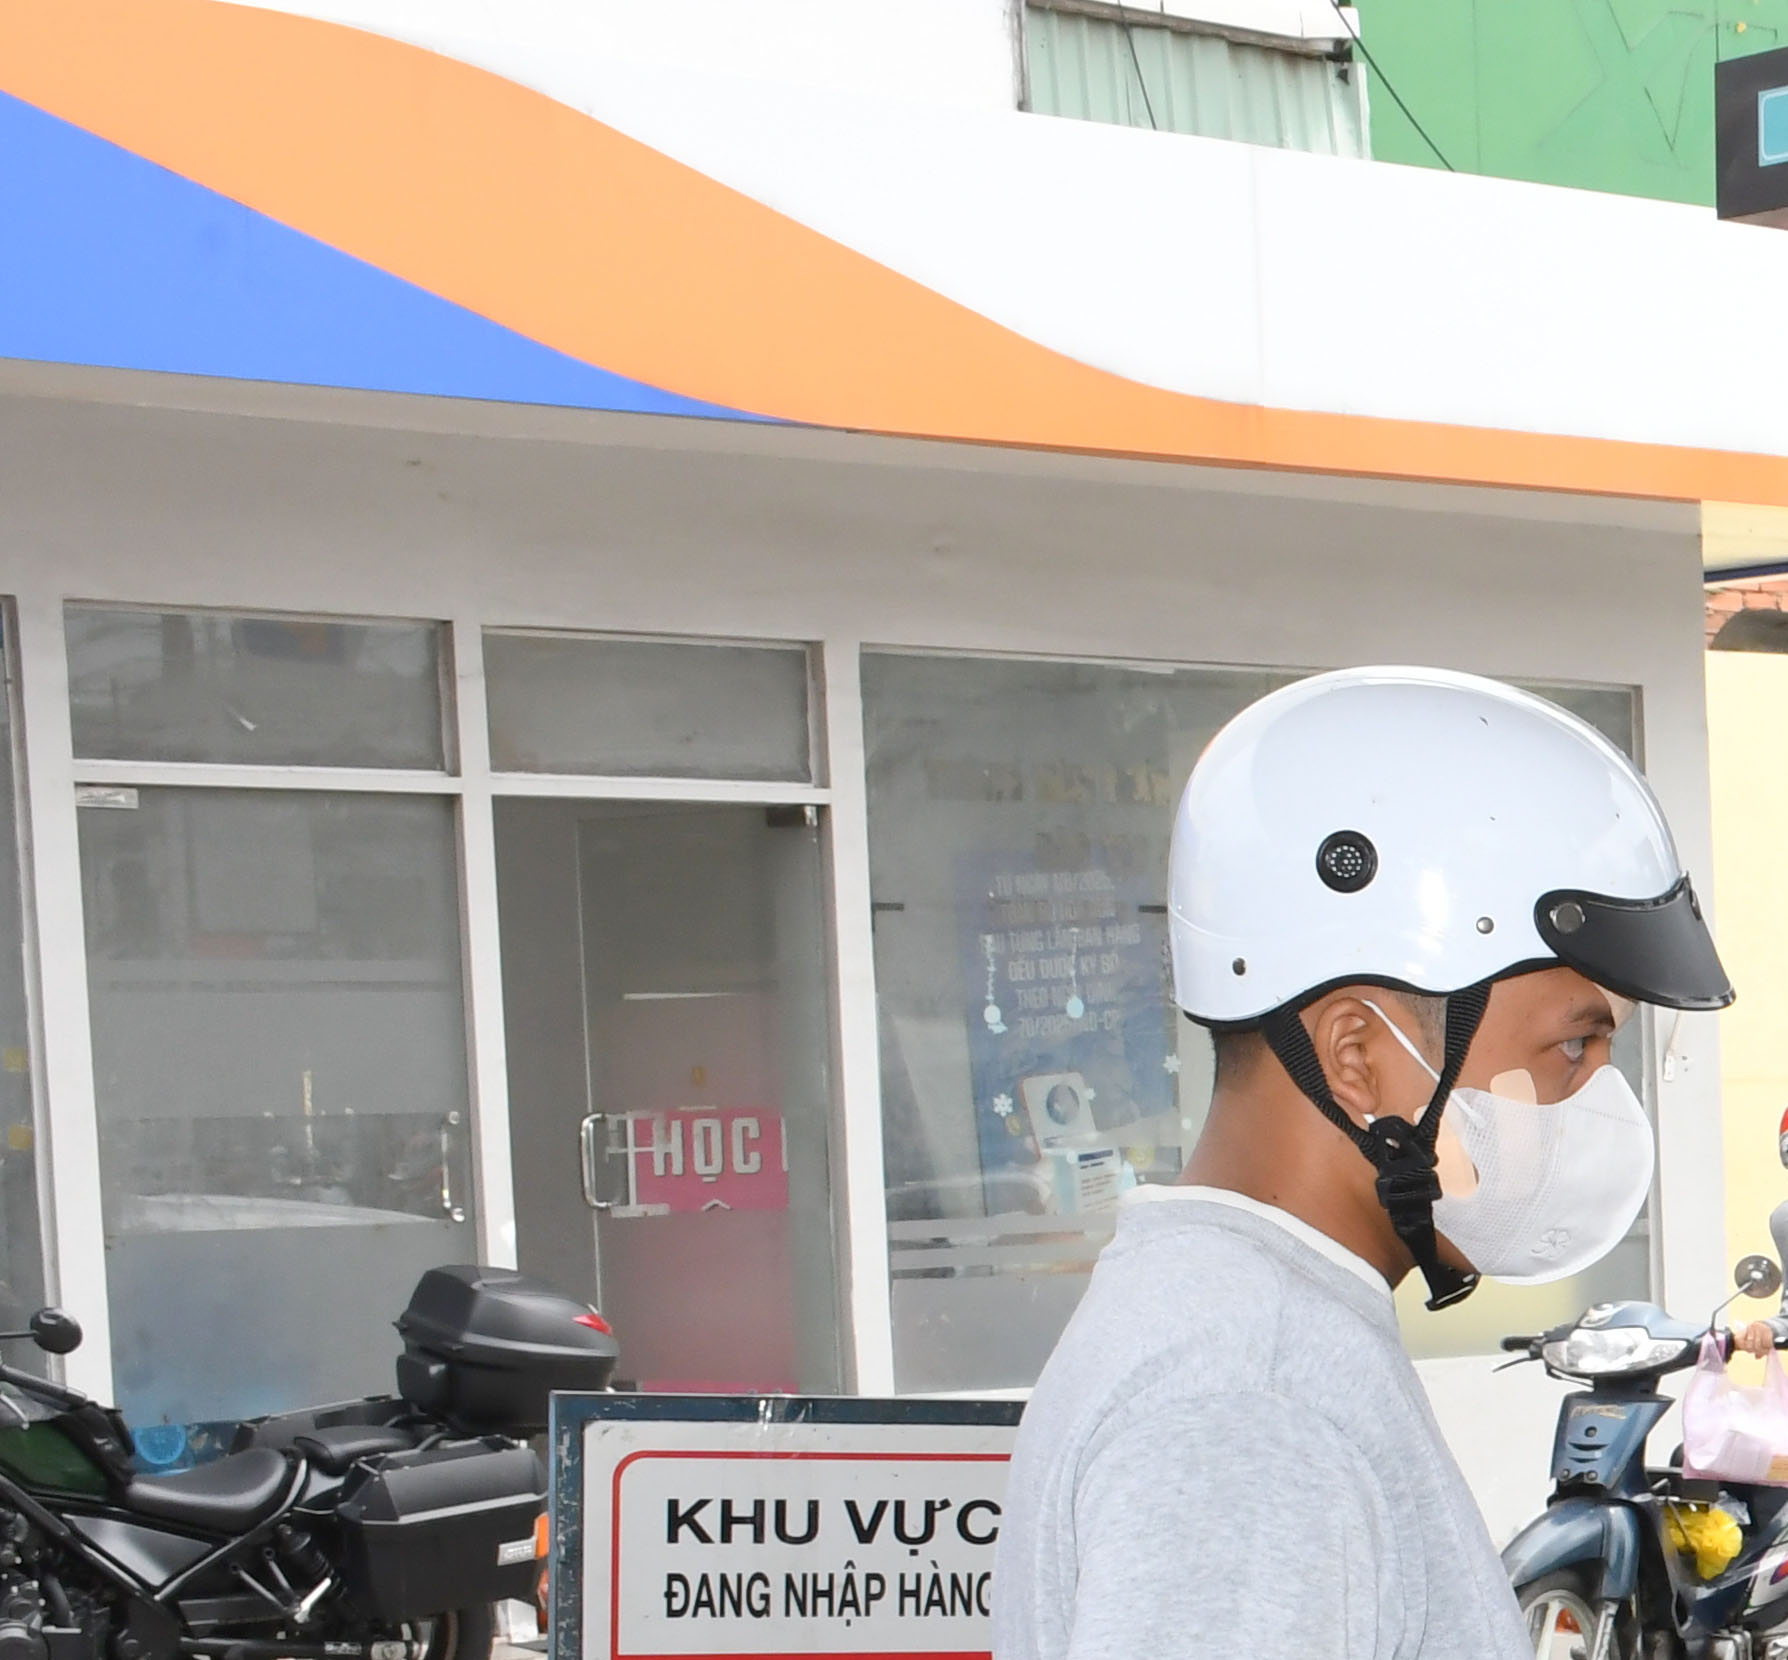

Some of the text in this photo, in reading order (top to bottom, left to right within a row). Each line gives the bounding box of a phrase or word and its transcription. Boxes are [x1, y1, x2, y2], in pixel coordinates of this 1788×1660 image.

[665, 1497, 1002, 1557] KHU VỰC
[664, 1571, 770, 1618] ĐANG
[783, 1560, 887, 1627] NHẬP
